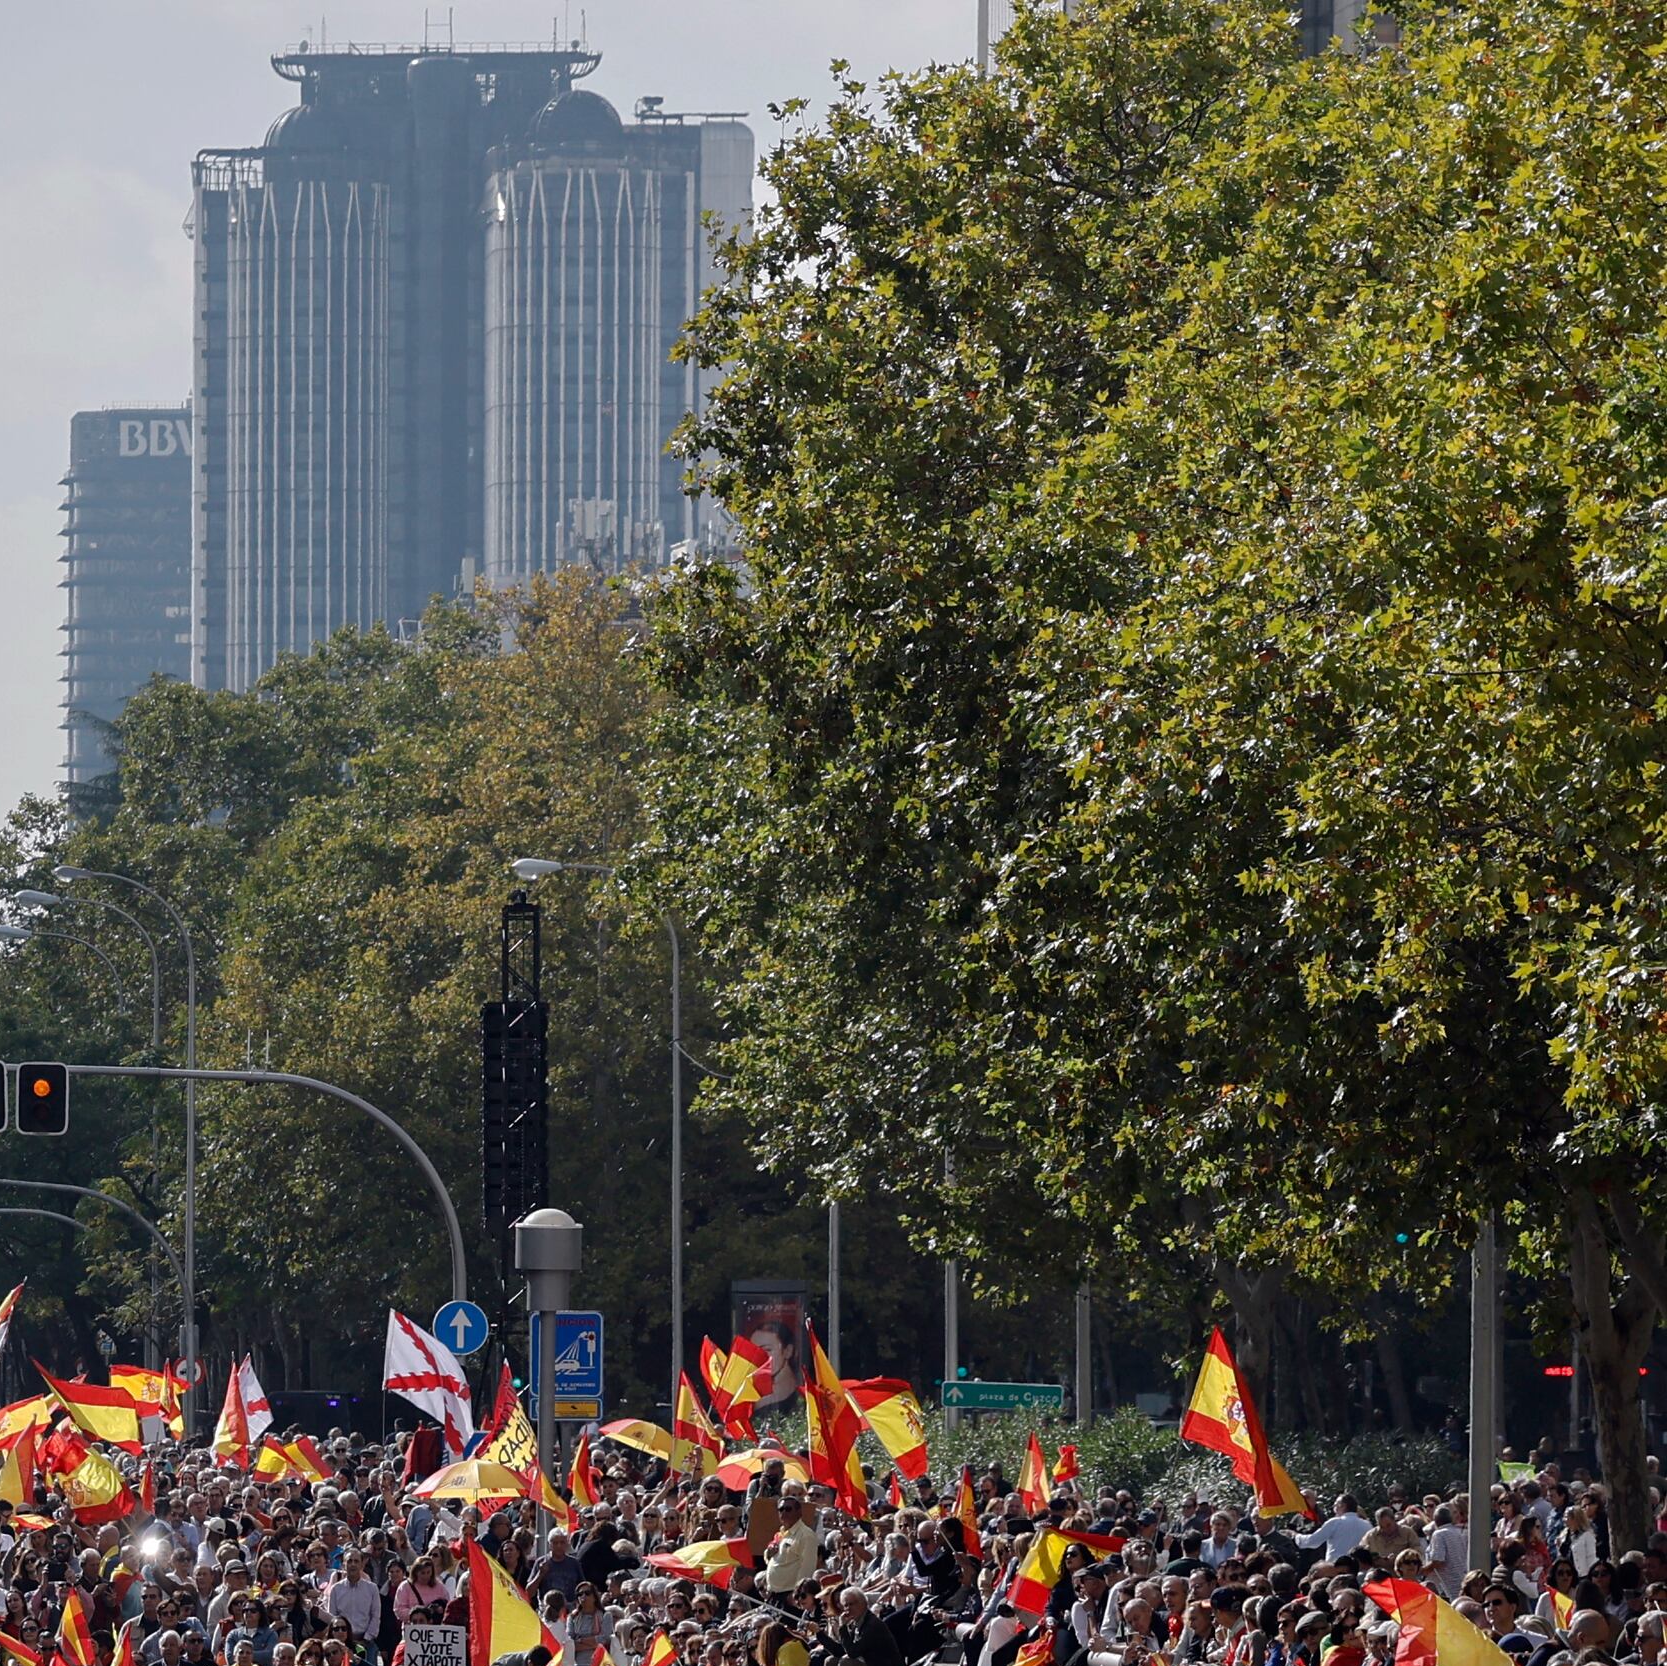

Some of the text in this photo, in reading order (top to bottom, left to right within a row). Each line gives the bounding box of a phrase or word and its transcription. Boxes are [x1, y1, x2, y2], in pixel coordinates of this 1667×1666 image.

[979, 1392, 1060, 1403] plaza de Cuzco
[409, 1629, 459, 1644] QUE TE
[420, 1643, 452, 1655] VOTE
